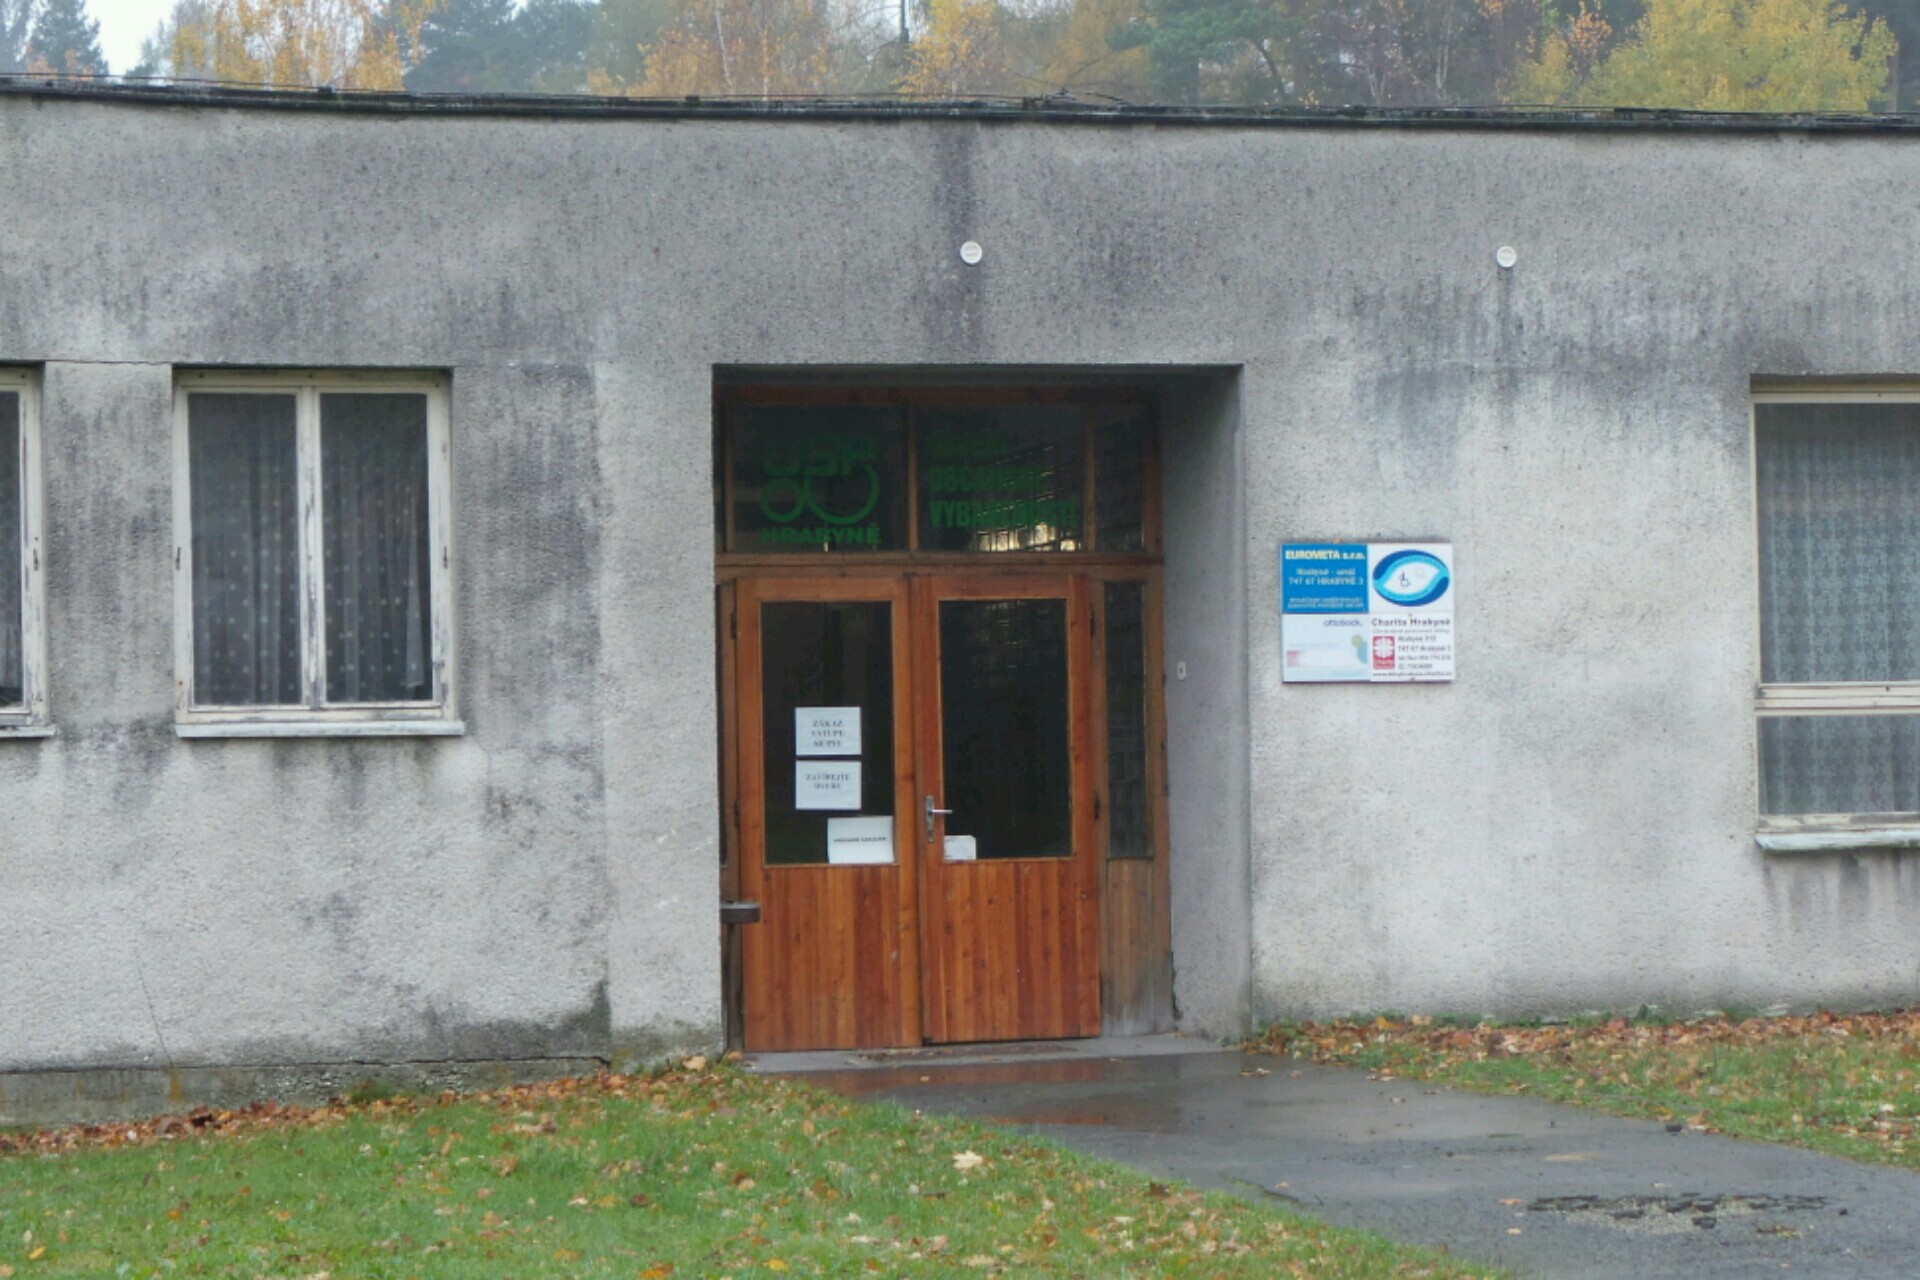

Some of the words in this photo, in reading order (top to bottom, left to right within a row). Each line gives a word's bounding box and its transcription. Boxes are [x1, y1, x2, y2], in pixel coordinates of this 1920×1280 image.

[760, 521, 881, 544] HRABYNĚ
[1286, 550, 1340, 560] EUROMETA
[1342, 552, 1366, 560] s.r.o.
[1371, 618, 1407, 627] Charita
[1410, 617, 1451, 628] Hrabyně
